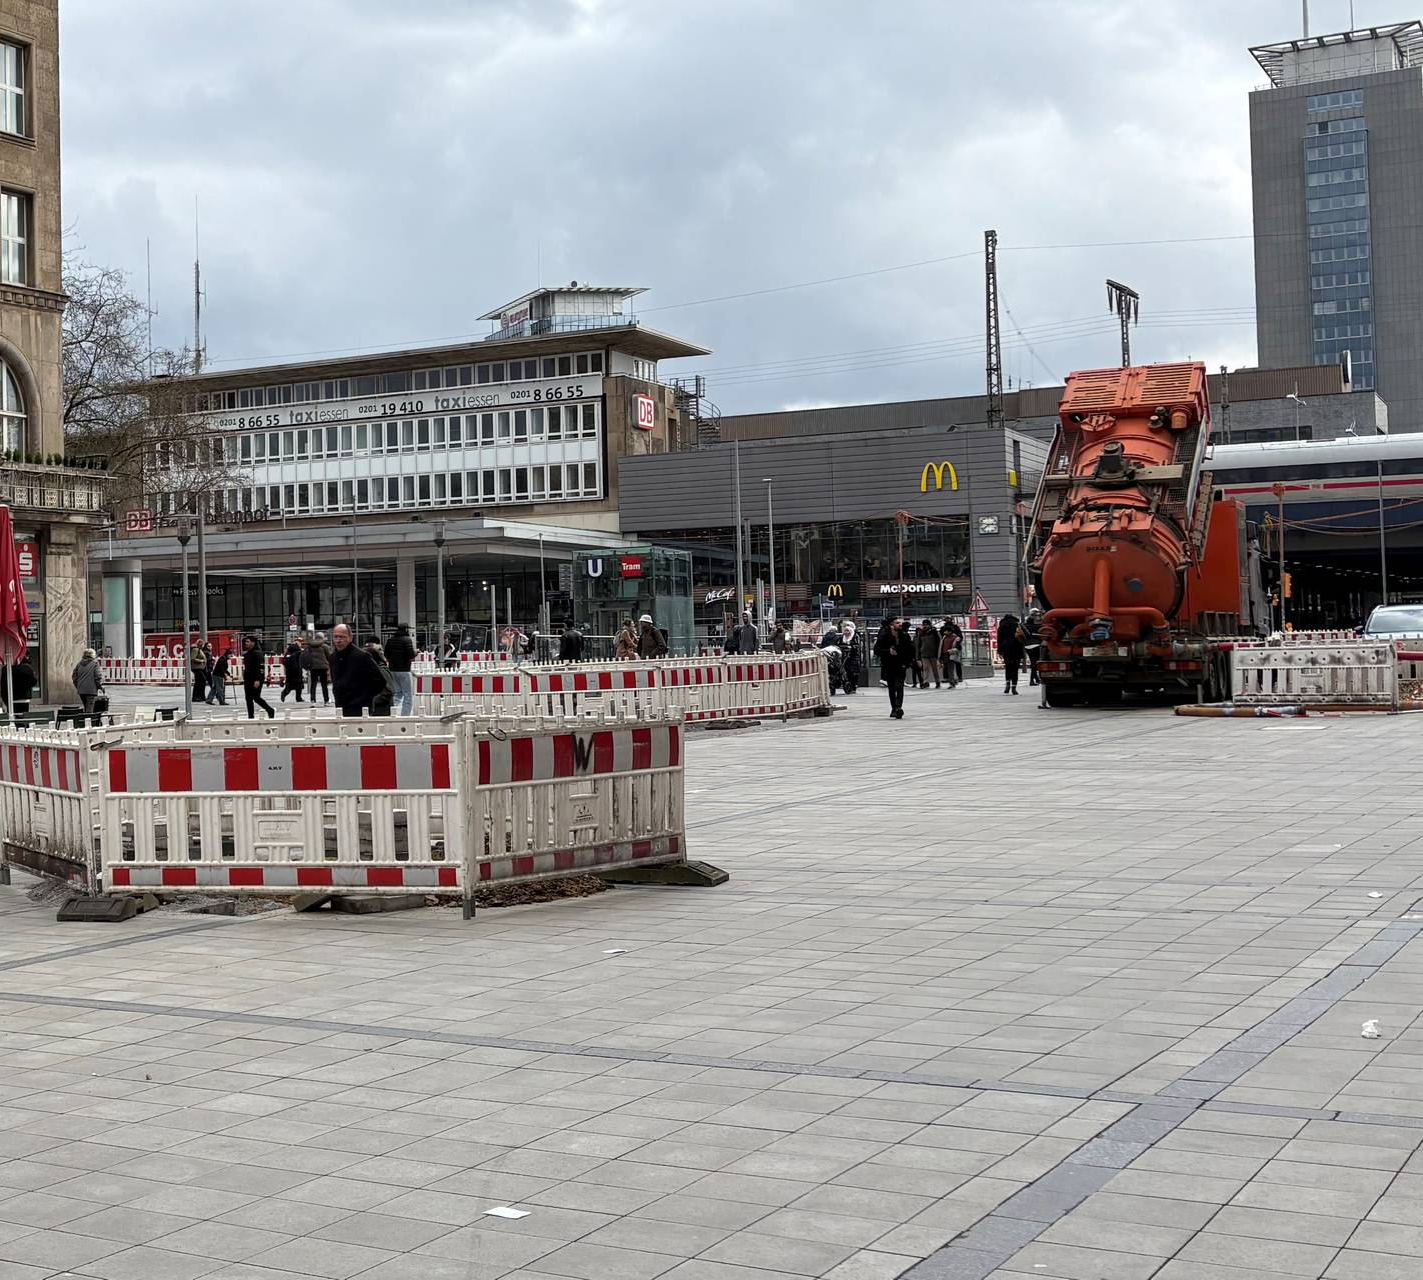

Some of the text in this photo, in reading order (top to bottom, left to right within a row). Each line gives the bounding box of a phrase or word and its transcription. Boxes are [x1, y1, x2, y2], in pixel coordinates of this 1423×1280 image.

[238, 418, 245, 429] 8
[248, 415, 263, 428] 66
[266, 414, 280, 426] 55
[358, 405, 377, 414] 0201
[381, 403, 396, 415] 19
[399, 400, 424, 414] 410
[510, 389, 531, 400] 0201
[533, 388, 542, 402] 8
[545, 386, 563, 400] 66
[567, 384, 584, 398] 55
[639, 397, 654, 425] DB
[127, 511, 150, 530] DB
[588, 559, 603, 577] U
[621, 562, 641, 571] Tram
